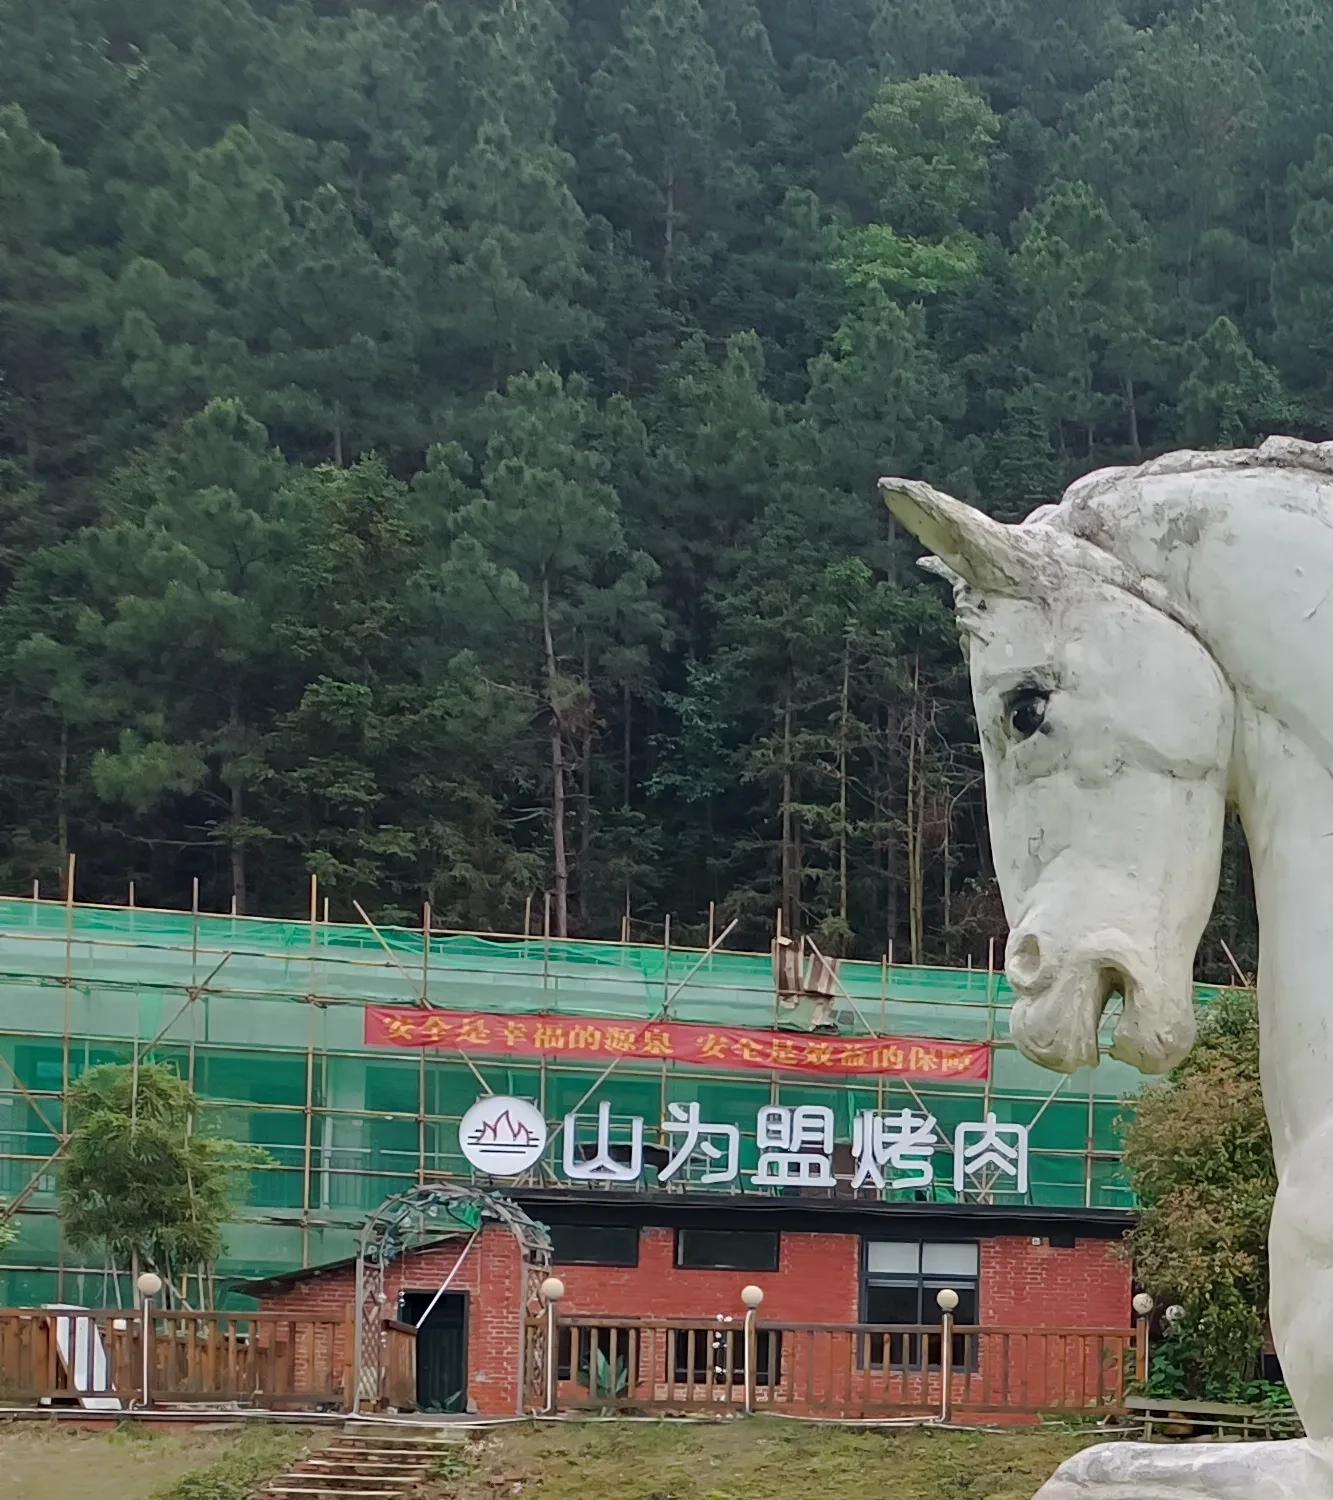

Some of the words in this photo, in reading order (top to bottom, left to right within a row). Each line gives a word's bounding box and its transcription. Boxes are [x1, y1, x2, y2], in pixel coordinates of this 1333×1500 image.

[383, 1016, 674, 1054] 安全是幸福的源泉
[696, 1033, 973, 1072] 安全是效益的保障
[563, 1101, 1028, 1194] 山为盟烤肉
